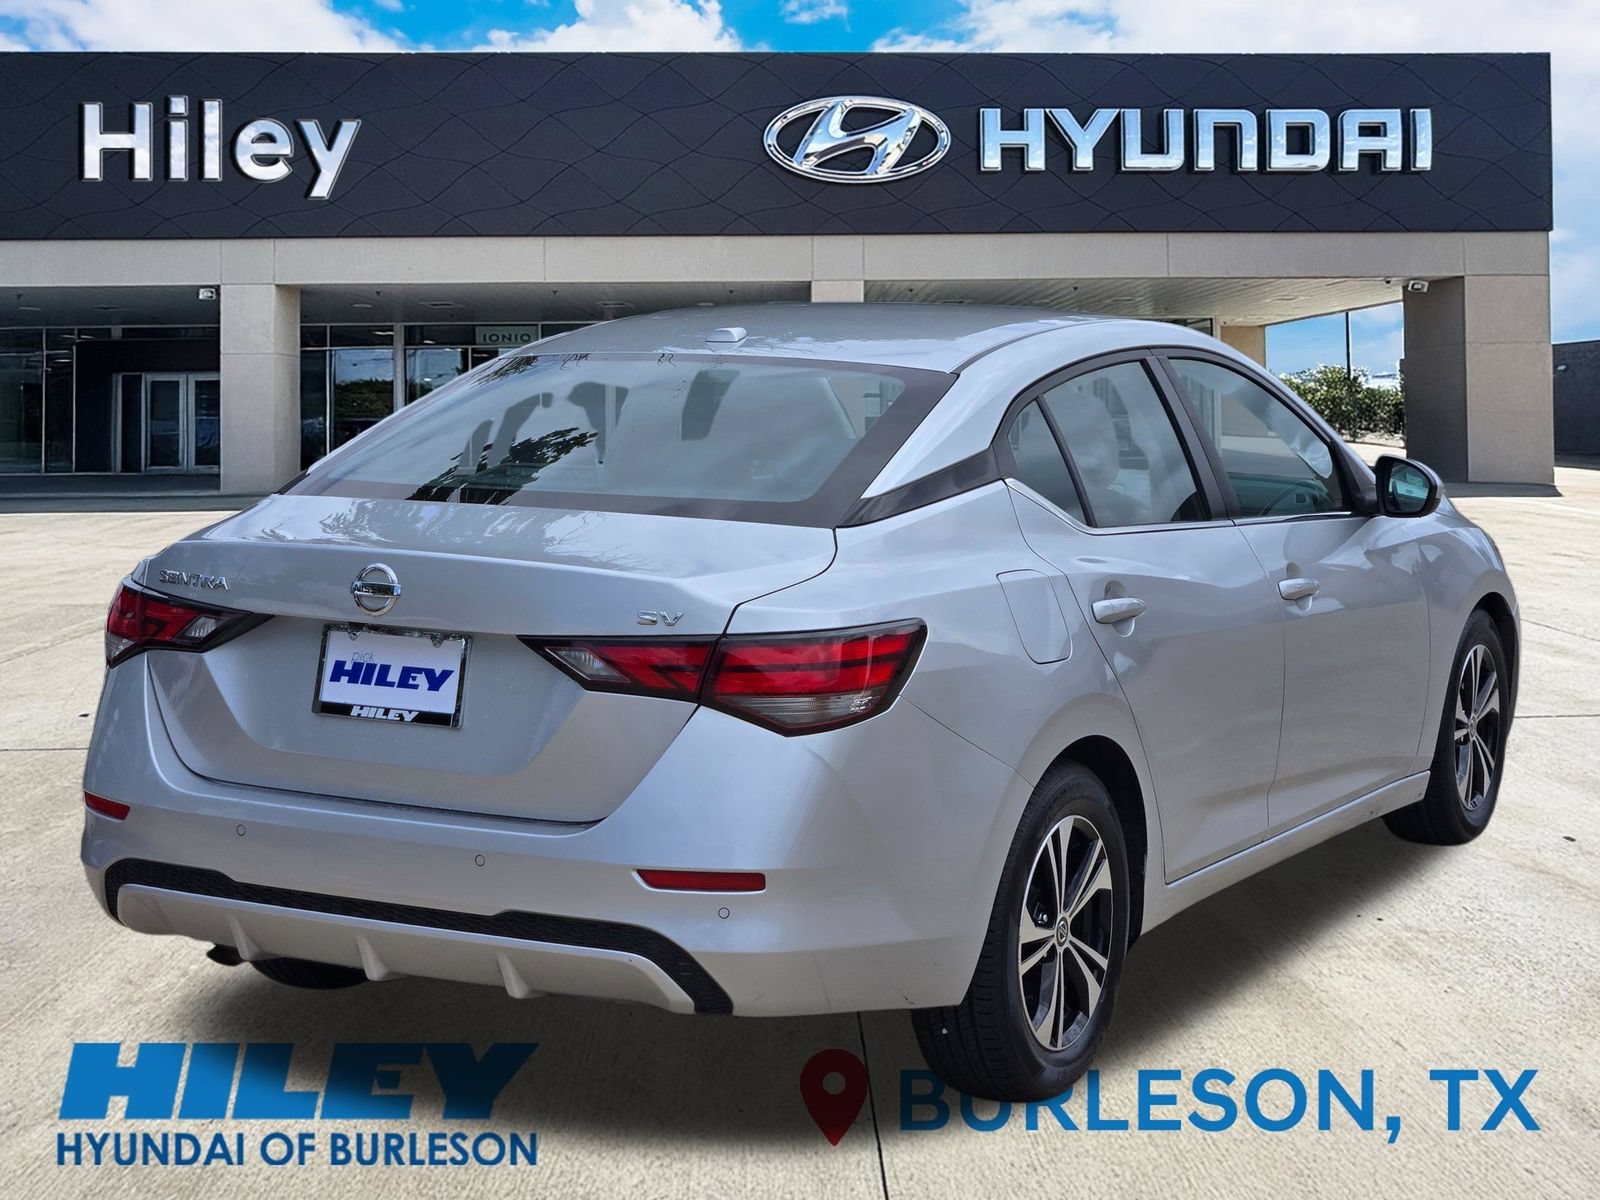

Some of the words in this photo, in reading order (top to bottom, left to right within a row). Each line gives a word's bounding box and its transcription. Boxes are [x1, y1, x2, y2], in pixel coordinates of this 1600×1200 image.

[80, 95, 362, 199] Hiley
[979, 107, 1432, 171] HYUNDAI
[159, 568, 229, 591] SENTRA
[637, 610, 684, 626] SV
[329, 660, 455, 692] HILEY
[350, 706, 419, 722] HILEY
